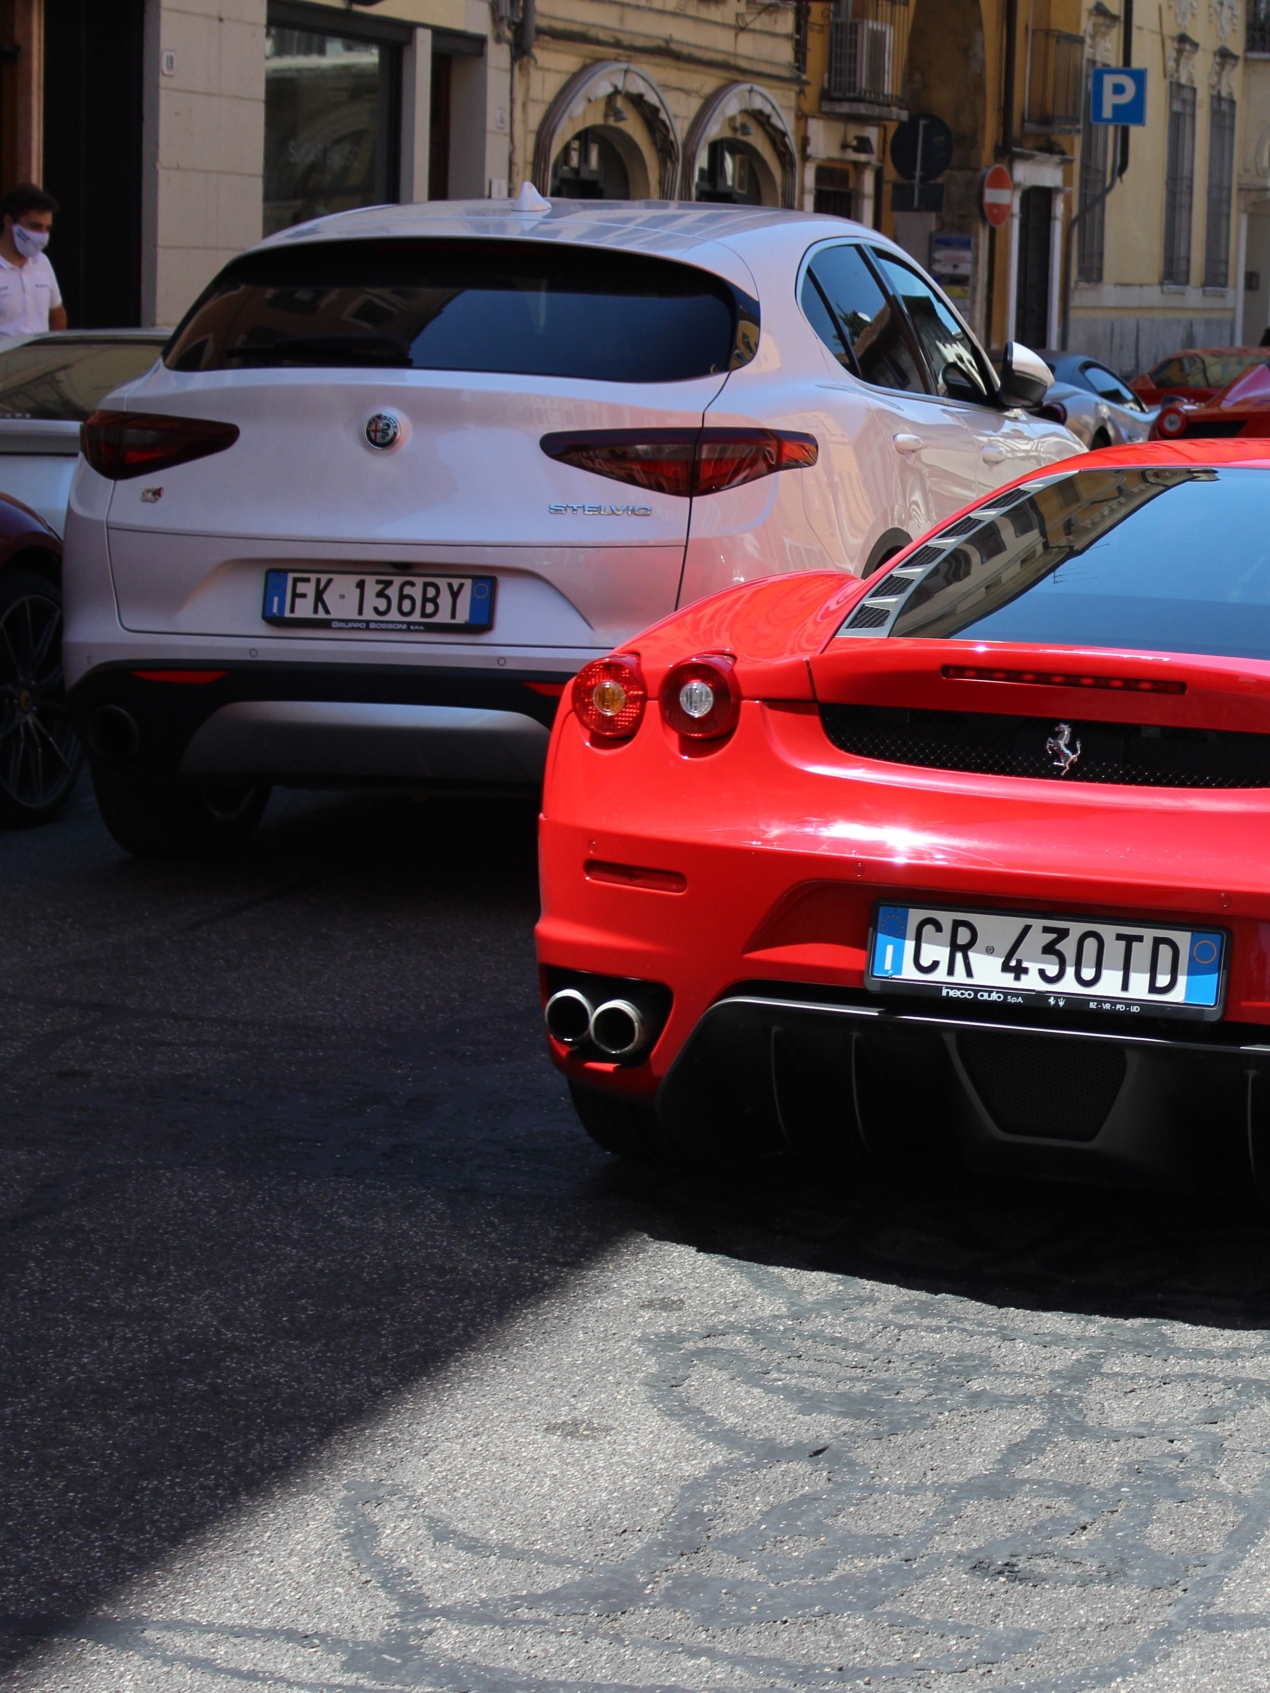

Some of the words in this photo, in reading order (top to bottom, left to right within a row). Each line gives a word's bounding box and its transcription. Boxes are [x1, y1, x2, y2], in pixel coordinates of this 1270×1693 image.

[1102, 73, 1136, 119] P
[548, 503, 652, 516] STELVIO
[289, 576, 334, 615] FK
[355, 578, 465, 620] 136BY
[331, 620, 366, 629] GRUPPO
[912, 916, 979, 979] CR
[1000, 923, 1180, 995] 430TD
[941, 986, 974, 999] ineco
[977, 988, 1004, 1002] auto
